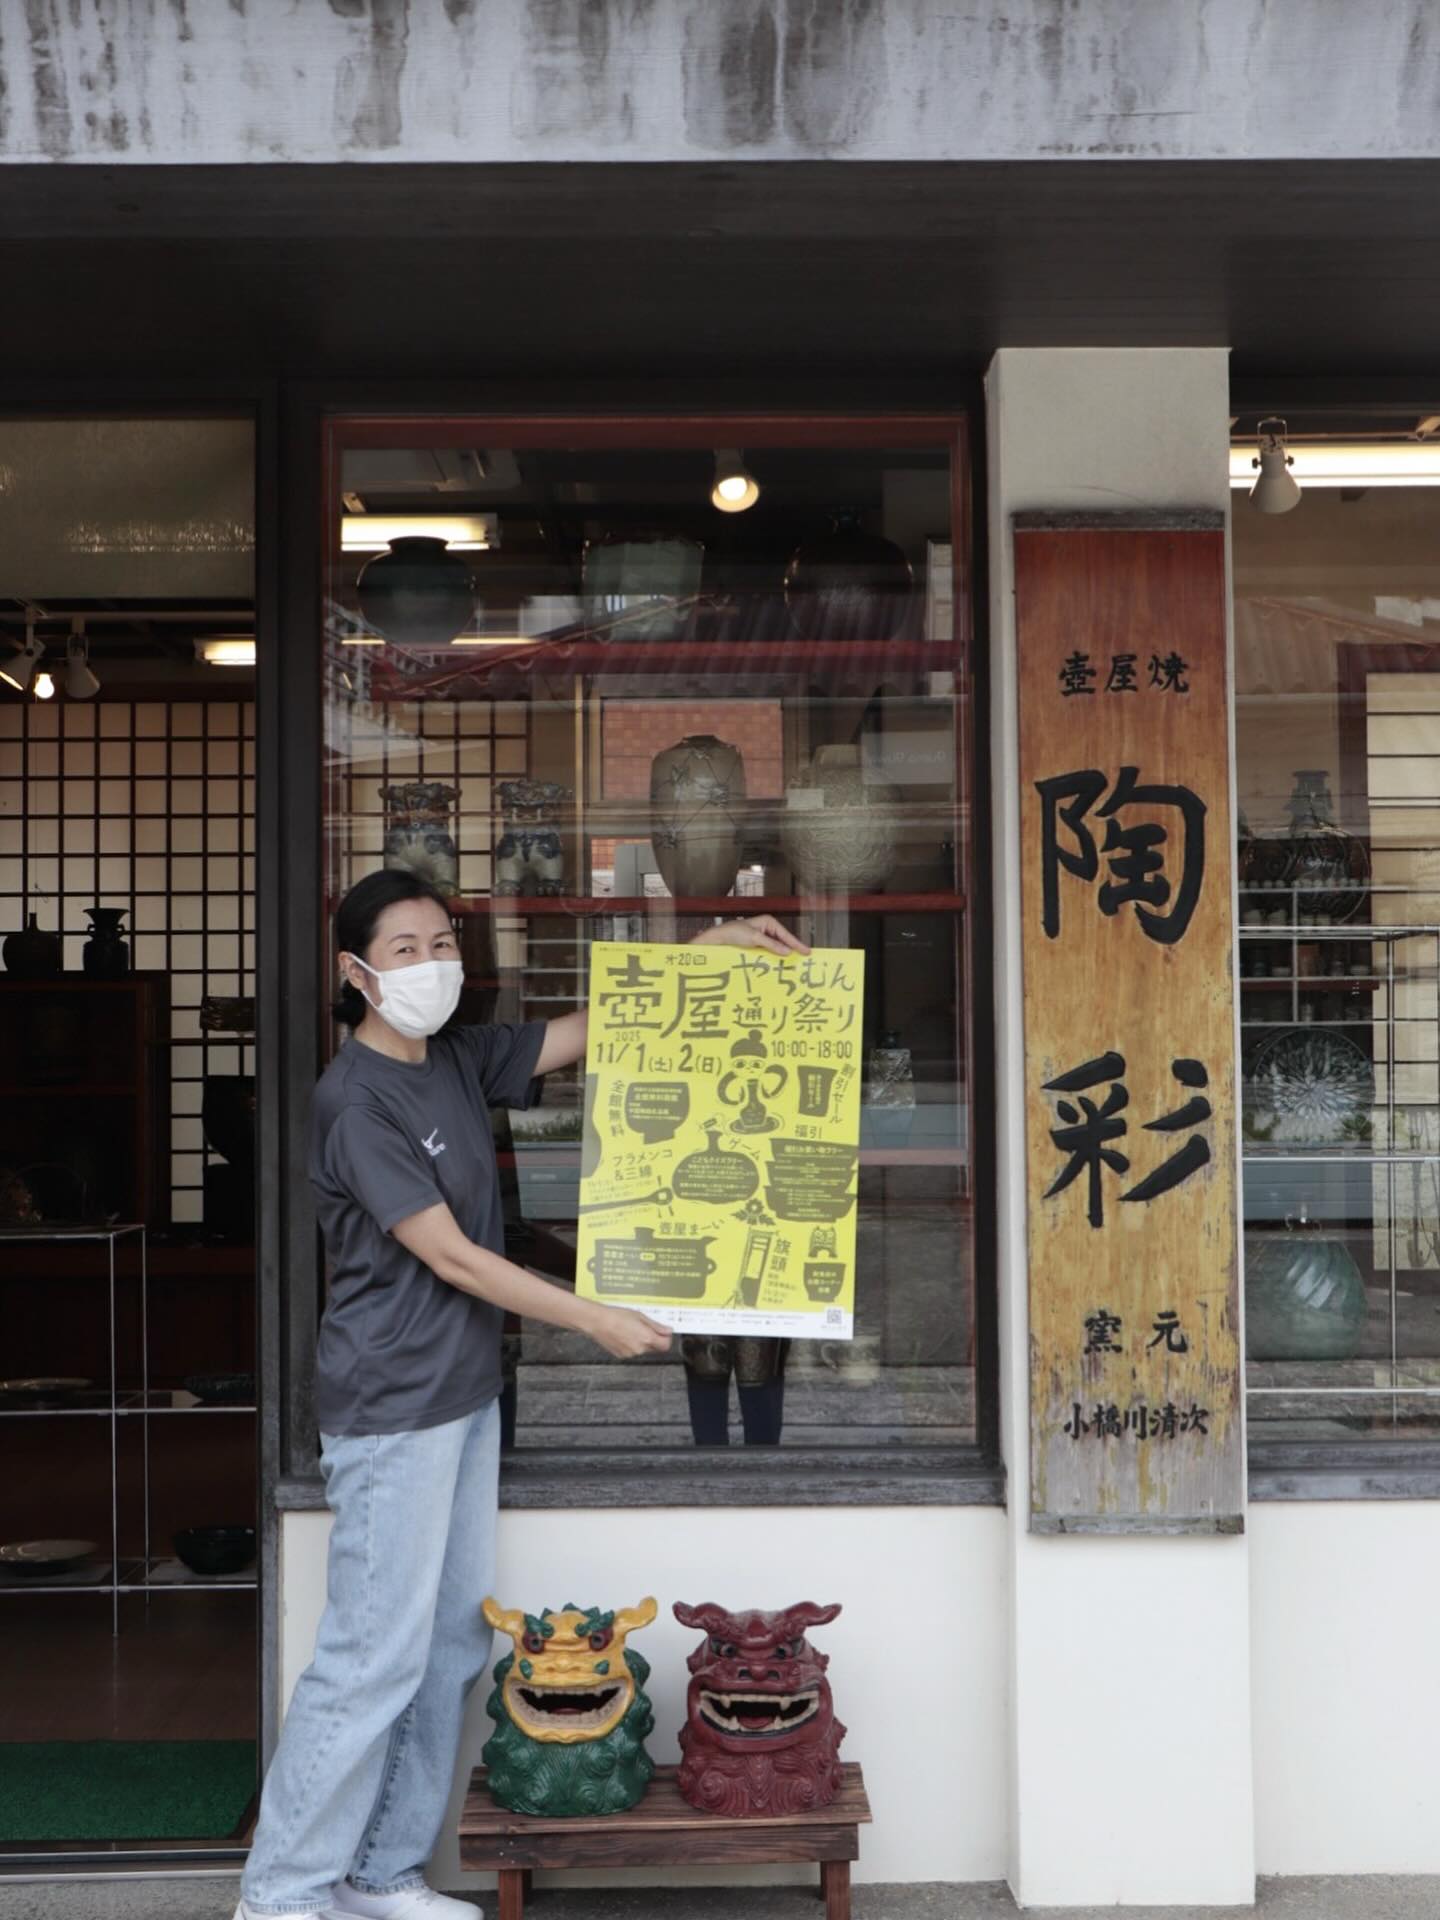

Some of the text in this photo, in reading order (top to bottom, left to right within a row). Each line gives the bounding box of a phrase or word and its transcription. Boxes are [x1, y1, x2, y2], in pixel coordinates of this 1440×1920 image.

[732, 953, 856, 996] やちむん
[732, 993, 855, 1034] 通り祭り
[1035, 766, 1211, 1228] 陶彩
[615, 1031, 641, 1042] 2025
[771, 1040, 853, 1059] 10:00-18:00
